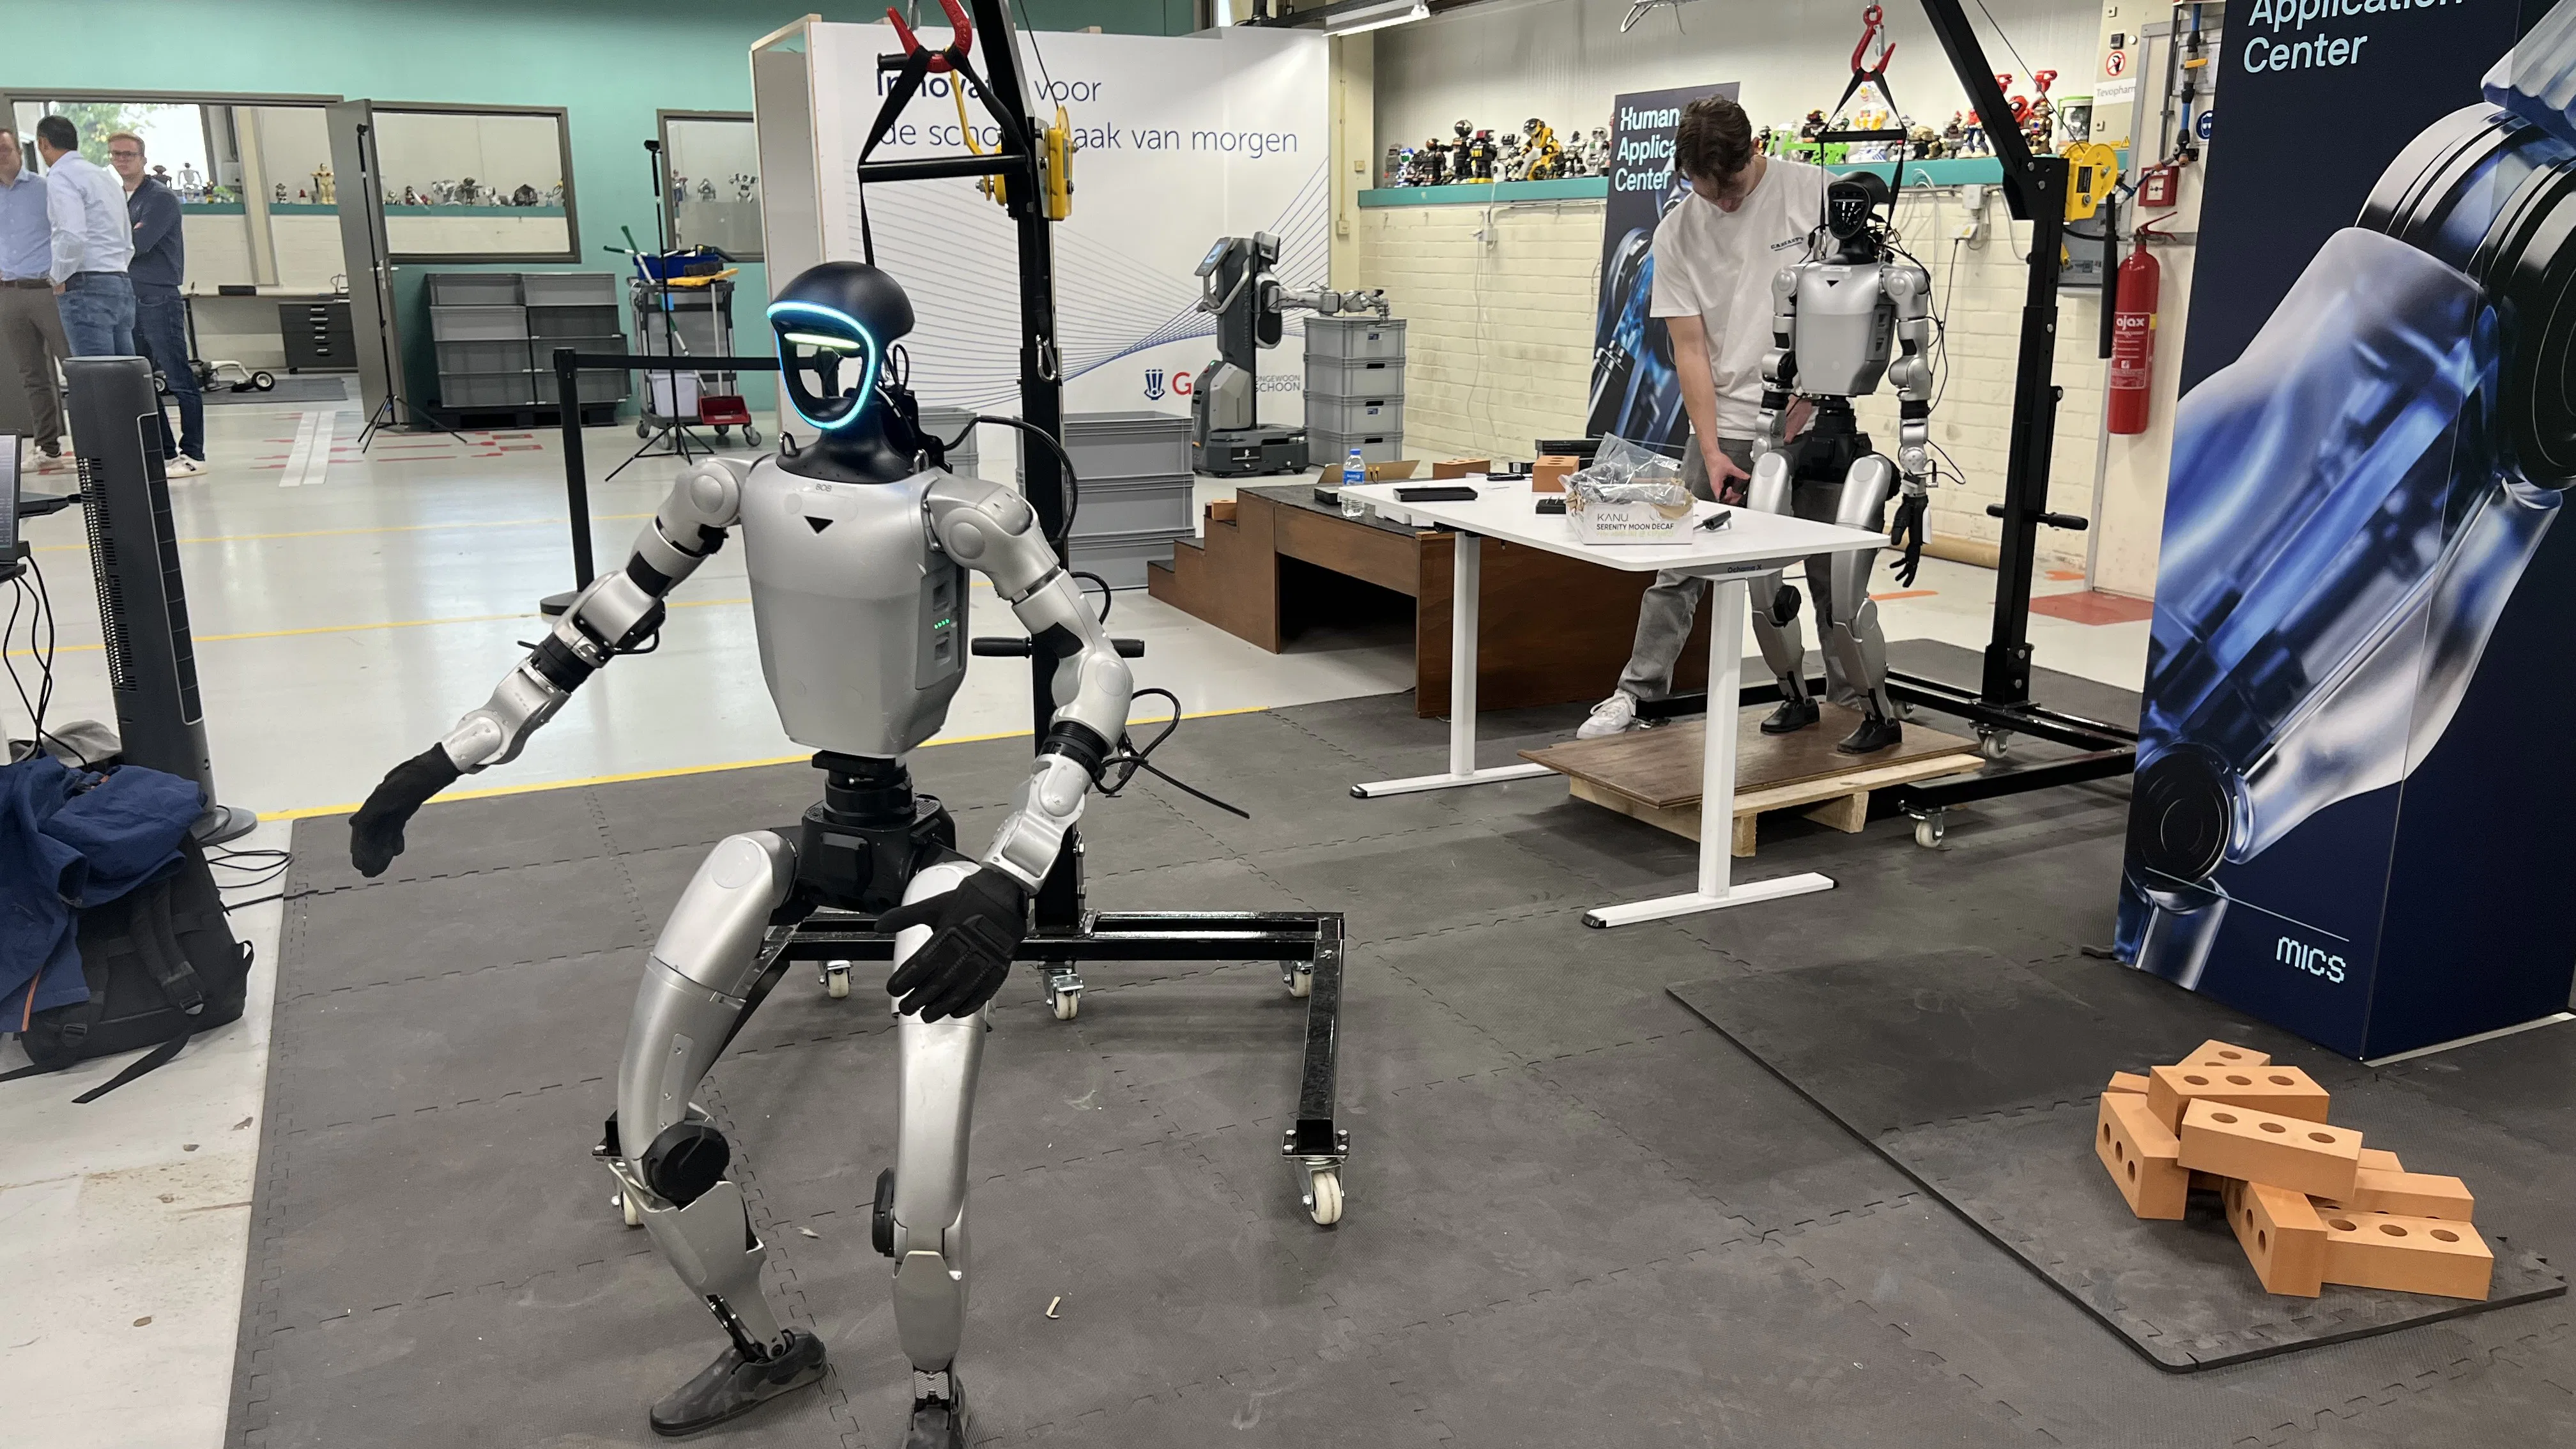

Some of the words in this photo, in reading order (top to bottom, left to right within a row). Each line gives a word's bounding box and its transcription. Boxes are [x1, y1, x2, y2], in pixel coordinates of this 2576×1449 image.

[2244, 33, 2368, 73] Center
[1034, 80, 1101, 102] voor
[1620, 106, 1680, 131] Human
[881, 124, 916, 145] de
[1131, 130, 1179, 150] van
[1192, 131, 1297, 158] morgen
[1614, 167, 1672, 192] Center
[2116, 316, 2145, 330] ajax
